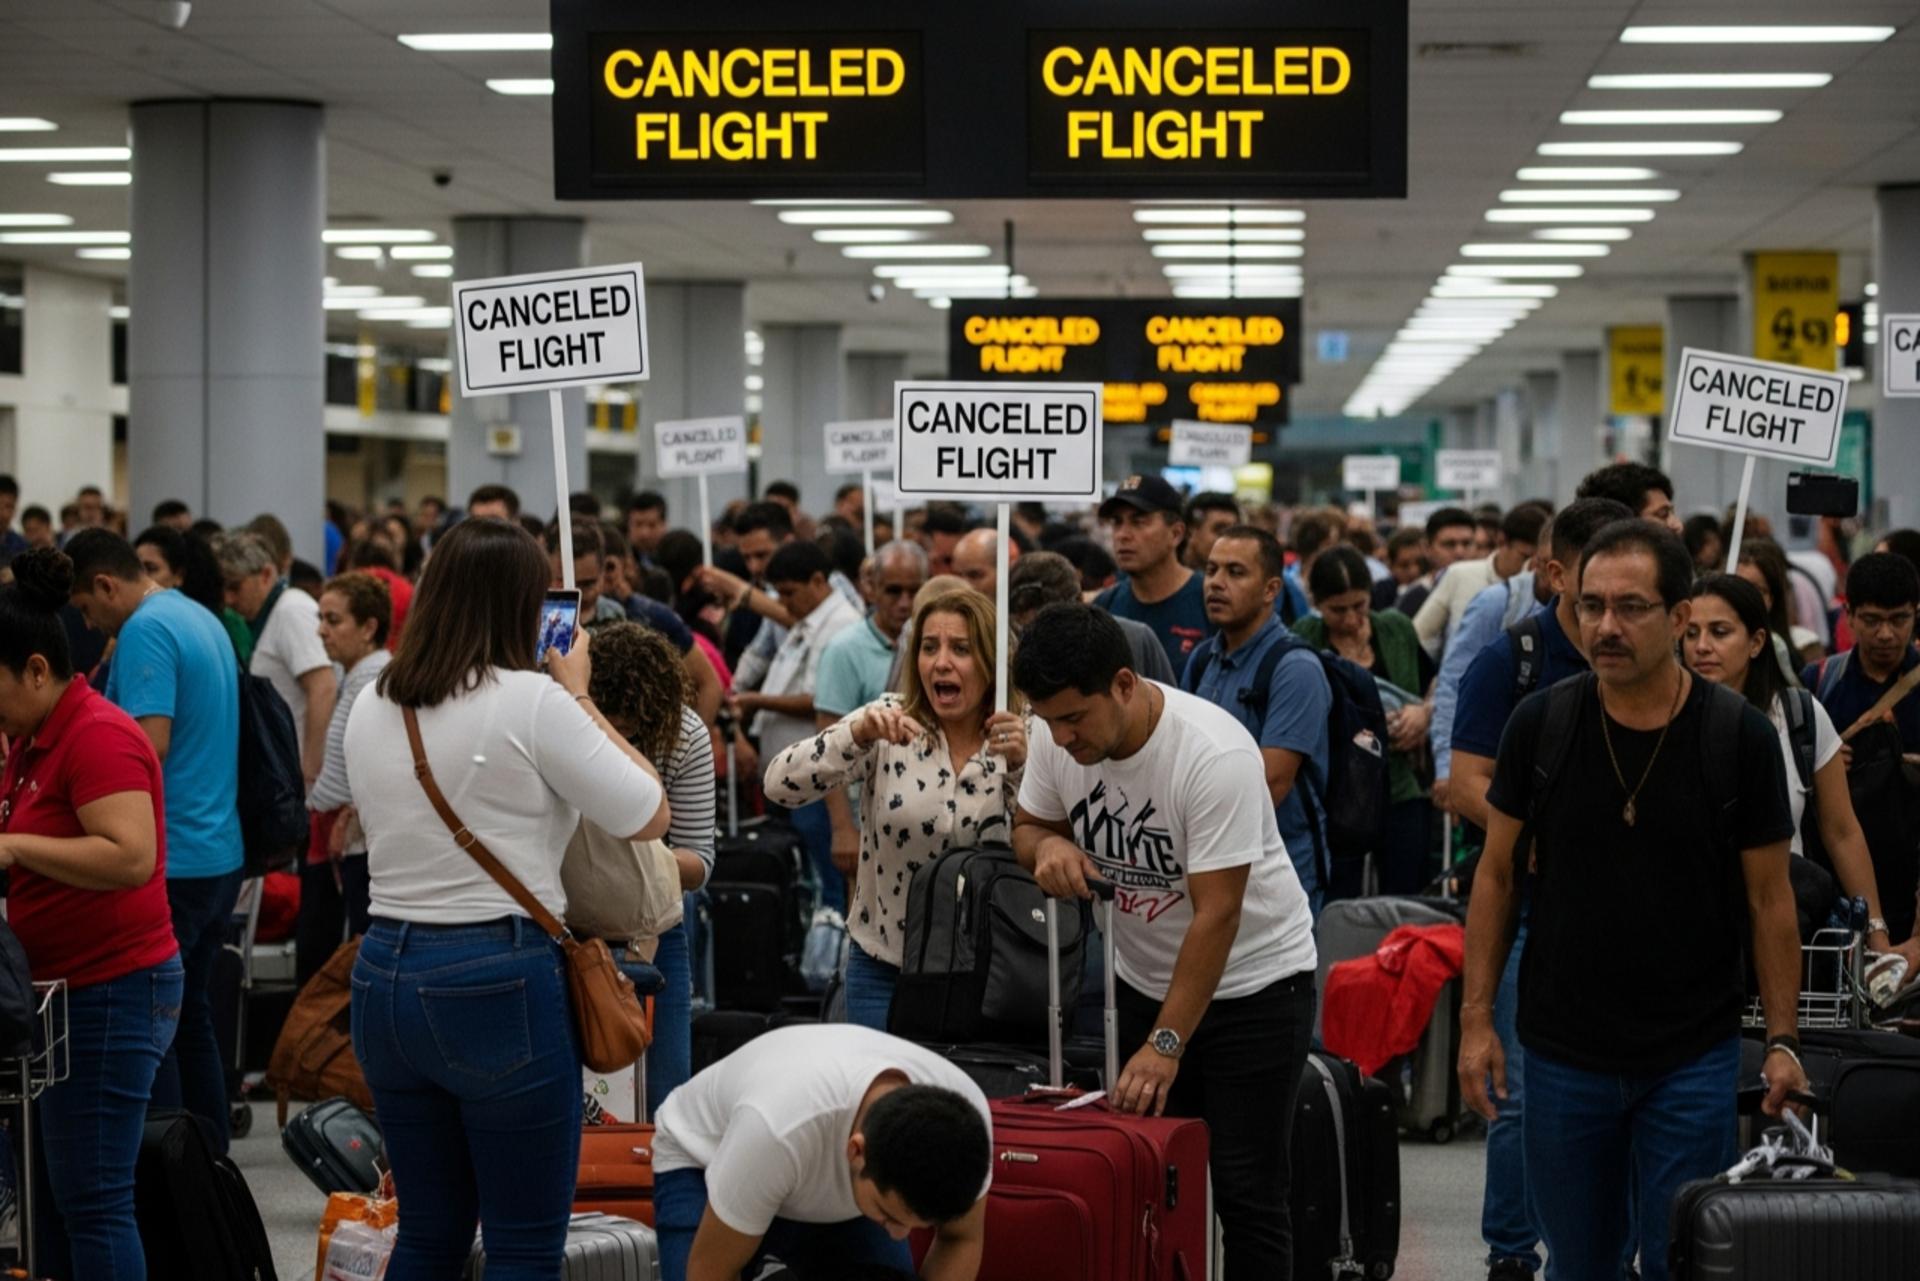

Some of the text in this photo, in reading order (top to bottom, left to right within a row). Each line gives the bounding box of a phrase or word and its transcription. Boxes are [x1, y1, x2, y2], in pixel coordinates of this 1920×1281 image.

[604, 48, 905, 98] CANCELED
[1043, 46, 1350, 97] CANCELED
[635, 111, 829, 160] FLIGHT
[1067, 110, 1263, 159] FLIGHT
[468, 285, 631, 331] CANCELED
[964, 316, 1101, 345] CANCELED
[1145, 316, 1284, 345] CANCELED
[499, 331, 605, 372] FLIGHT
[980, 345, 1067, 373] FLIGHT
[1156, 345, 1247, 373] FLIGHT
[1689, 366, 1834, 413] CANCELED
[908, 401, 1087, 434] CANCELED
[1706, 404, 1806, 444] FLIGHT
[937, 447, 1056, 480] FLIGHT
